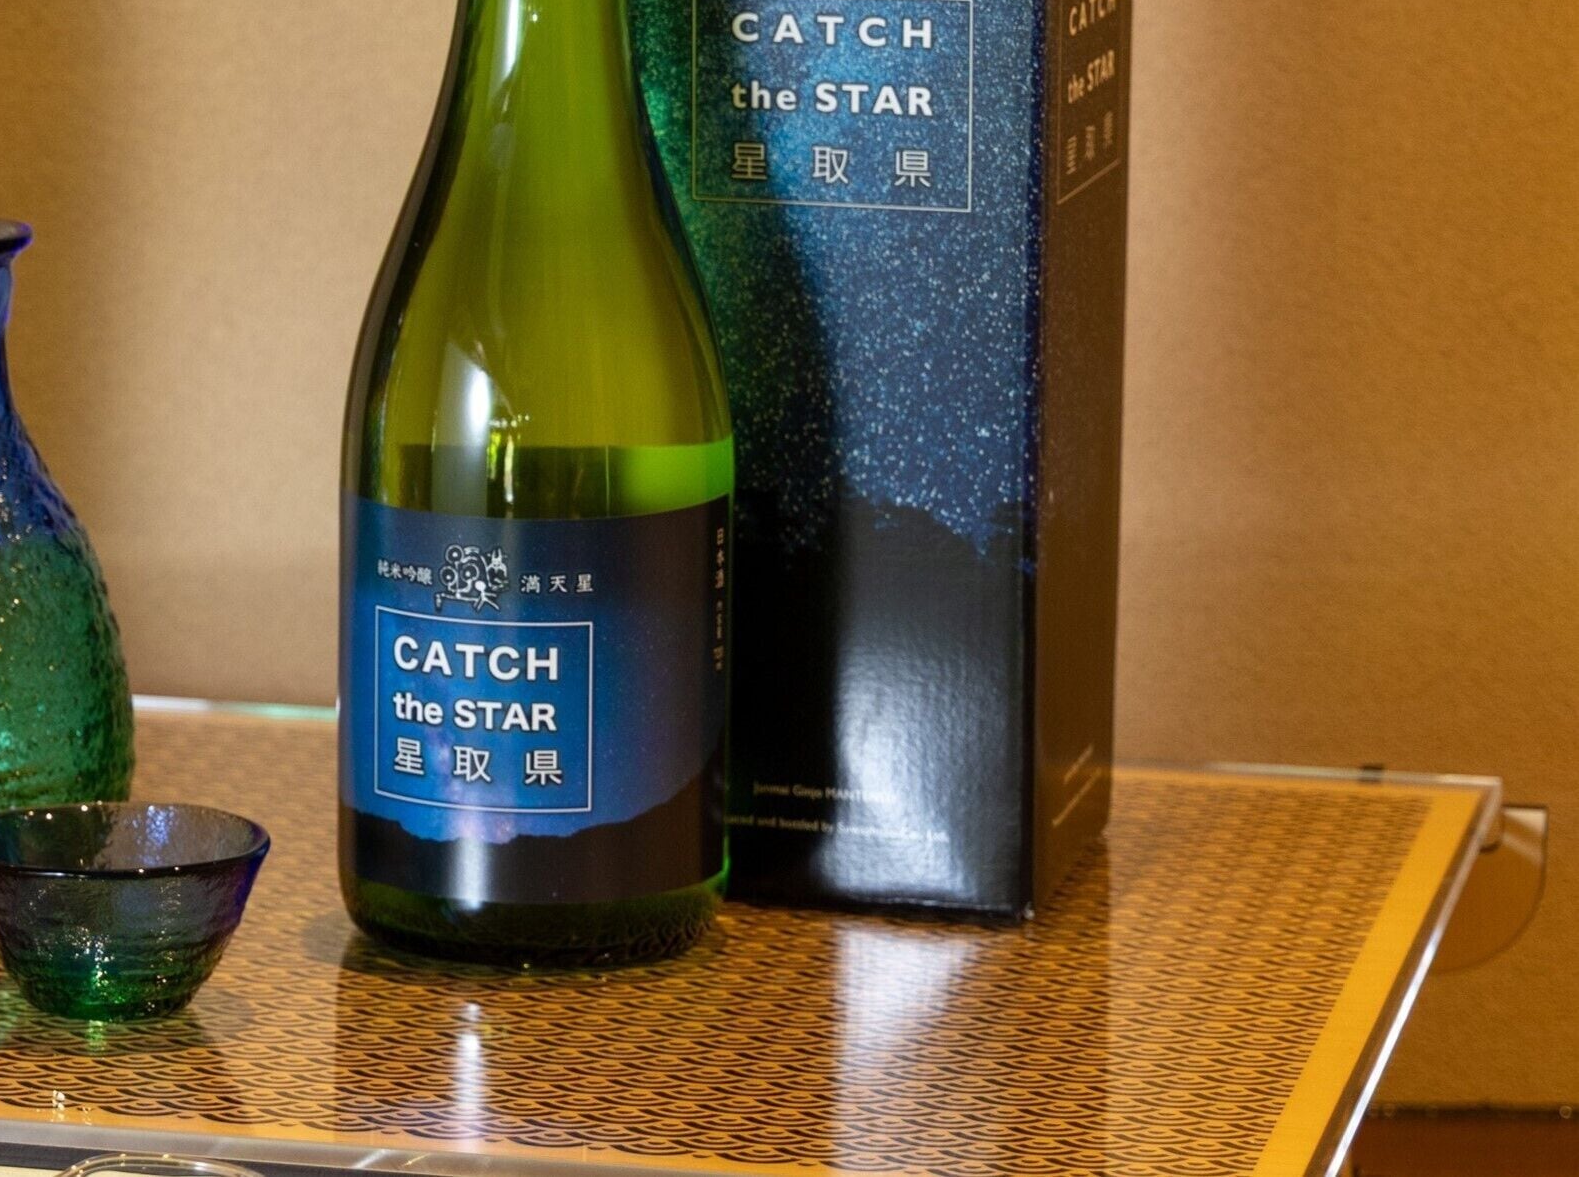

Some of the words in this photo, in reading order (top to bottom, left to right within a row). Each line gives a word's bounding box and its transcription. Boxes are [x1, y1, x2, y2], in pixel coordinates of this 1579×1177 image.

[731, 12, 933, 49] CATCH
[1086, 49, 1116, 92] STAR
[731, 80, 797, 111] the
[815, 82, 934, 117] STAR
[730, 142, 932, 188] 星取県
[377, 559, 433, 586] 純米吟醸
[520, 573, 594, 594] 満天星
[393, 635, 559, 681] CATCH
[393, 692, 444, 725] the
[453, 699, 557, 732] STAR
[393, 737, 563, 786] 星取県
